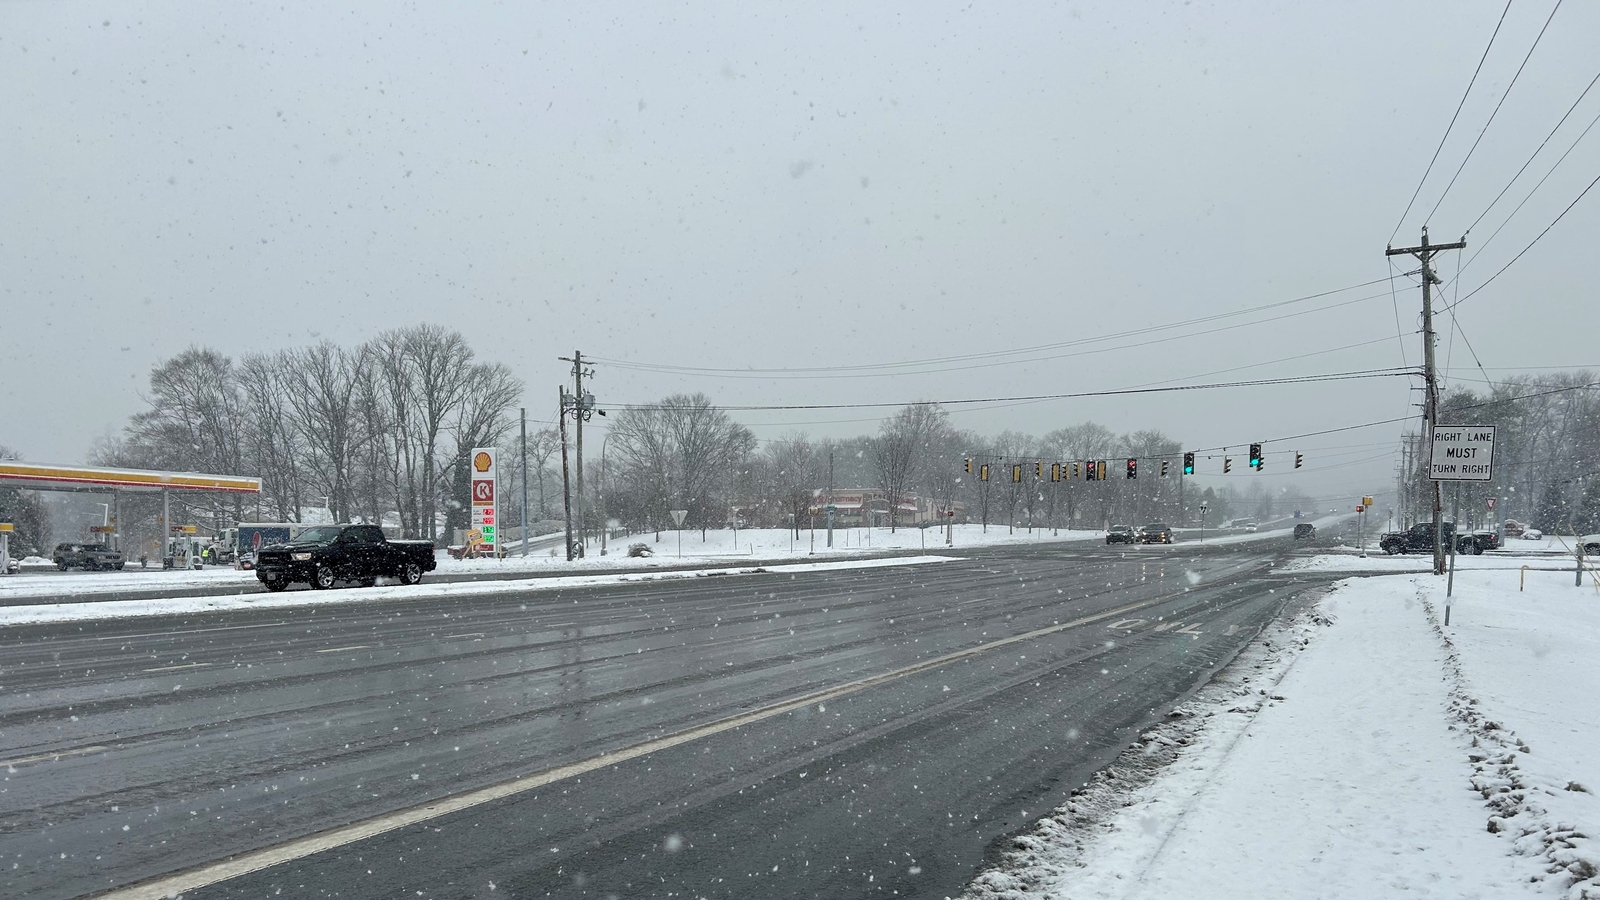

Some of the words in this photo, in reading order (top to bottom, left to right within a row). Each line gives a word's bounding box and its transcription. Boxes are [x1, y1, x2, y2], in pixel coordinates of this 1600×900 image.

[1434, 432, 1462, 442] RIGHT
[1467, 432, 1492, 442] LANE
[1446, 447, 1478, 459] MUST
[1433, 464, 1457, 473] TURN
[1461, 464, 1490, 474] RIGHT
